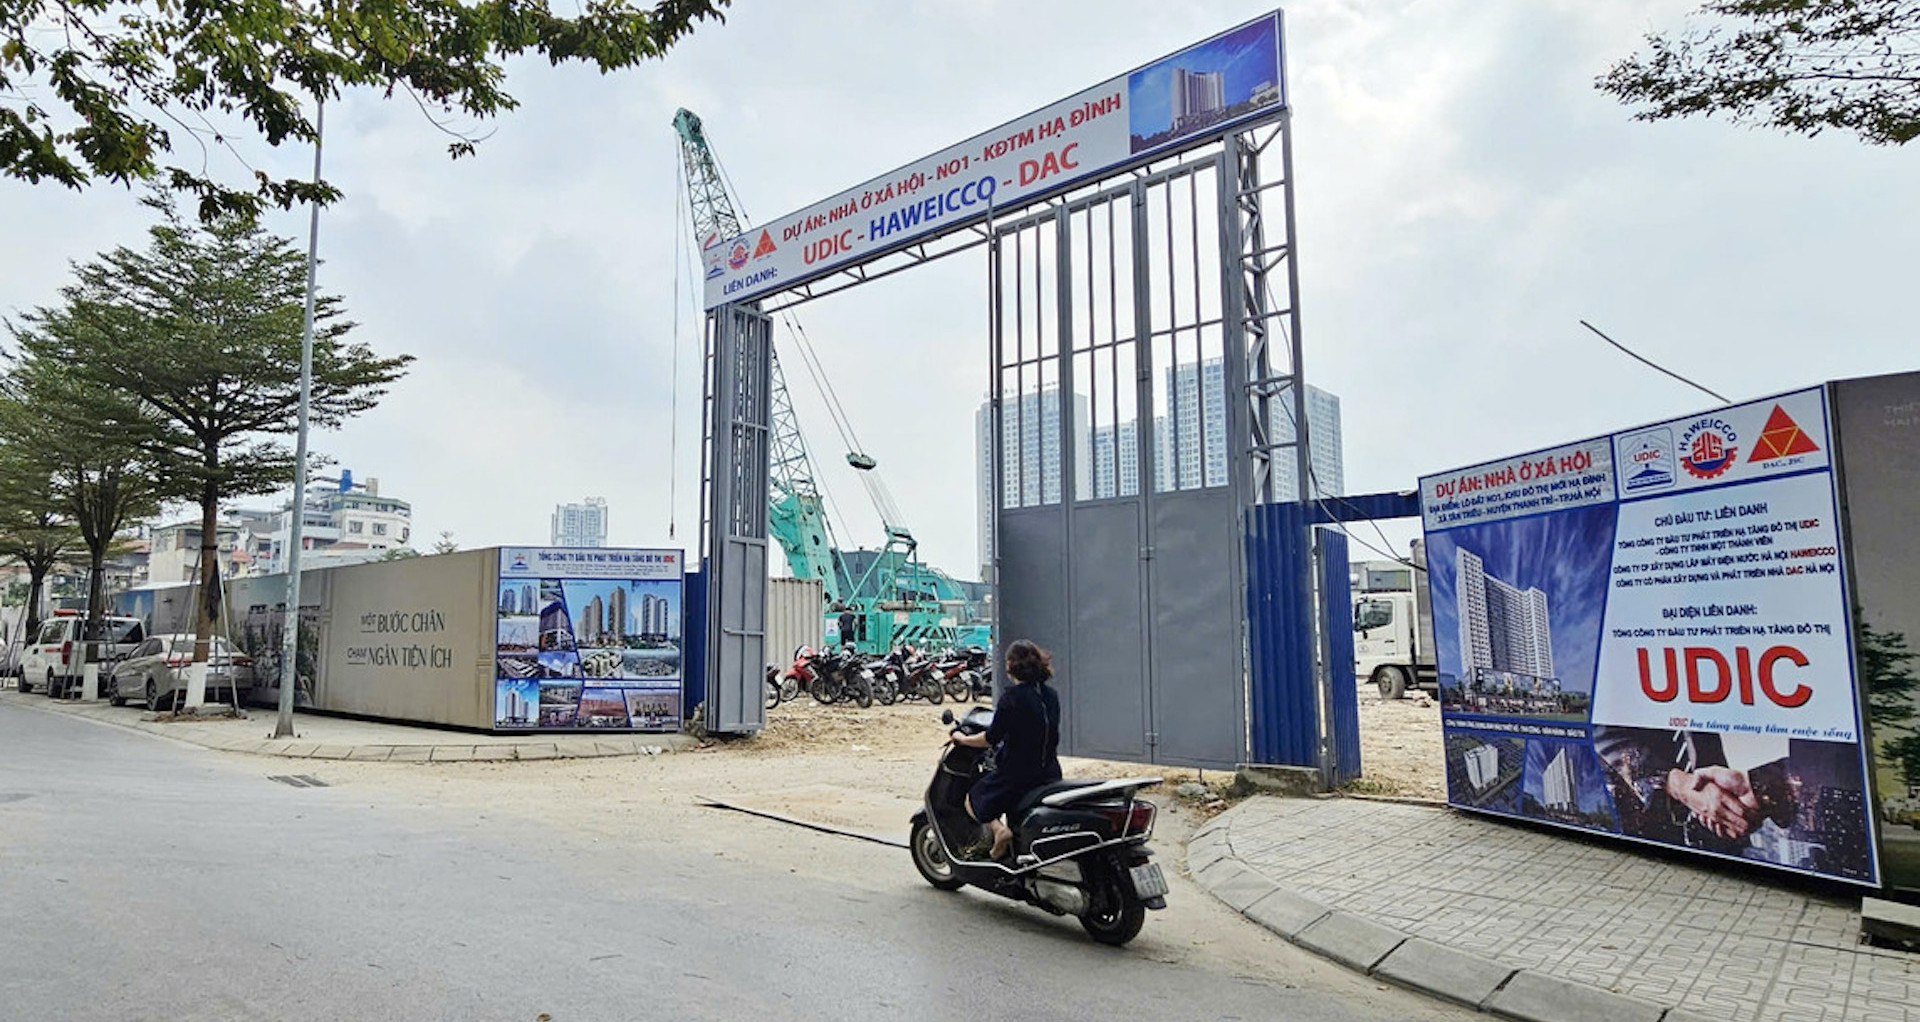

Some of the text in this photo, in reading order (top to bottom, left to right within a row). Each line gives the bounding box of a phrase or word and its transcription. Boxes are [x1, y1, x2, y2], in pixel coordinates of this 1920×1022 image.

[783, 220, 803, 241] DỰ
[804, 215, 827, 234] ÁN:
[829, 198, 858, 223] NHÀ
[861, 191, 872, 209] Ở
[875, 182, 894, 205] XÃ
[897, 172, 925, 196] HỘI
[983, 128, 1034, 162] KĐTM
[1038, 117, 1066, 140] HẠ
[1068, 92, 1121, 128] ĐÌNH
[803, 228, 853, 265] UDIC
[870, 175, 996, 242] HAWEICCO
[1019, 142, 1079, 187] DAC
[723, 267, 778, 295] LIÊN DANH:
[1678, 418, 1738, 452] HAWEICCO
[1633, 449, 1661, 463] UDIC
[1436, 451, 1592, 498] DỰ ÁN: NHÀ Ở XÃ HỘI
[1654, 513, 1673, 527] CHỦ
[1675, 511, 1694, 525] ĐẦU
[1714, 505, 1736, 519] LIÊN
[1739, 502, 1768, 517] DANH
[1799, 518, 1820, 529] UDIC
[1789, 546, 1836, 559] HAWEICCO
[1785, 565, 1804, 575] DAC
[377, 610, 409, 633] BƯỚC
[412, 609, 445, 632] CHÂN
[1662, 603, 1758, 620] ĐẠI DIỆN LIÊN DANH:
[367, 643, 399, 666] NGÀN
[401, 644, 427, 670] TIỆN
[430, 644, 452, 668] ÍCH
[1636, 645, 1813, 708] UDIC
[1669, 717, 1688, 727] UDIC
